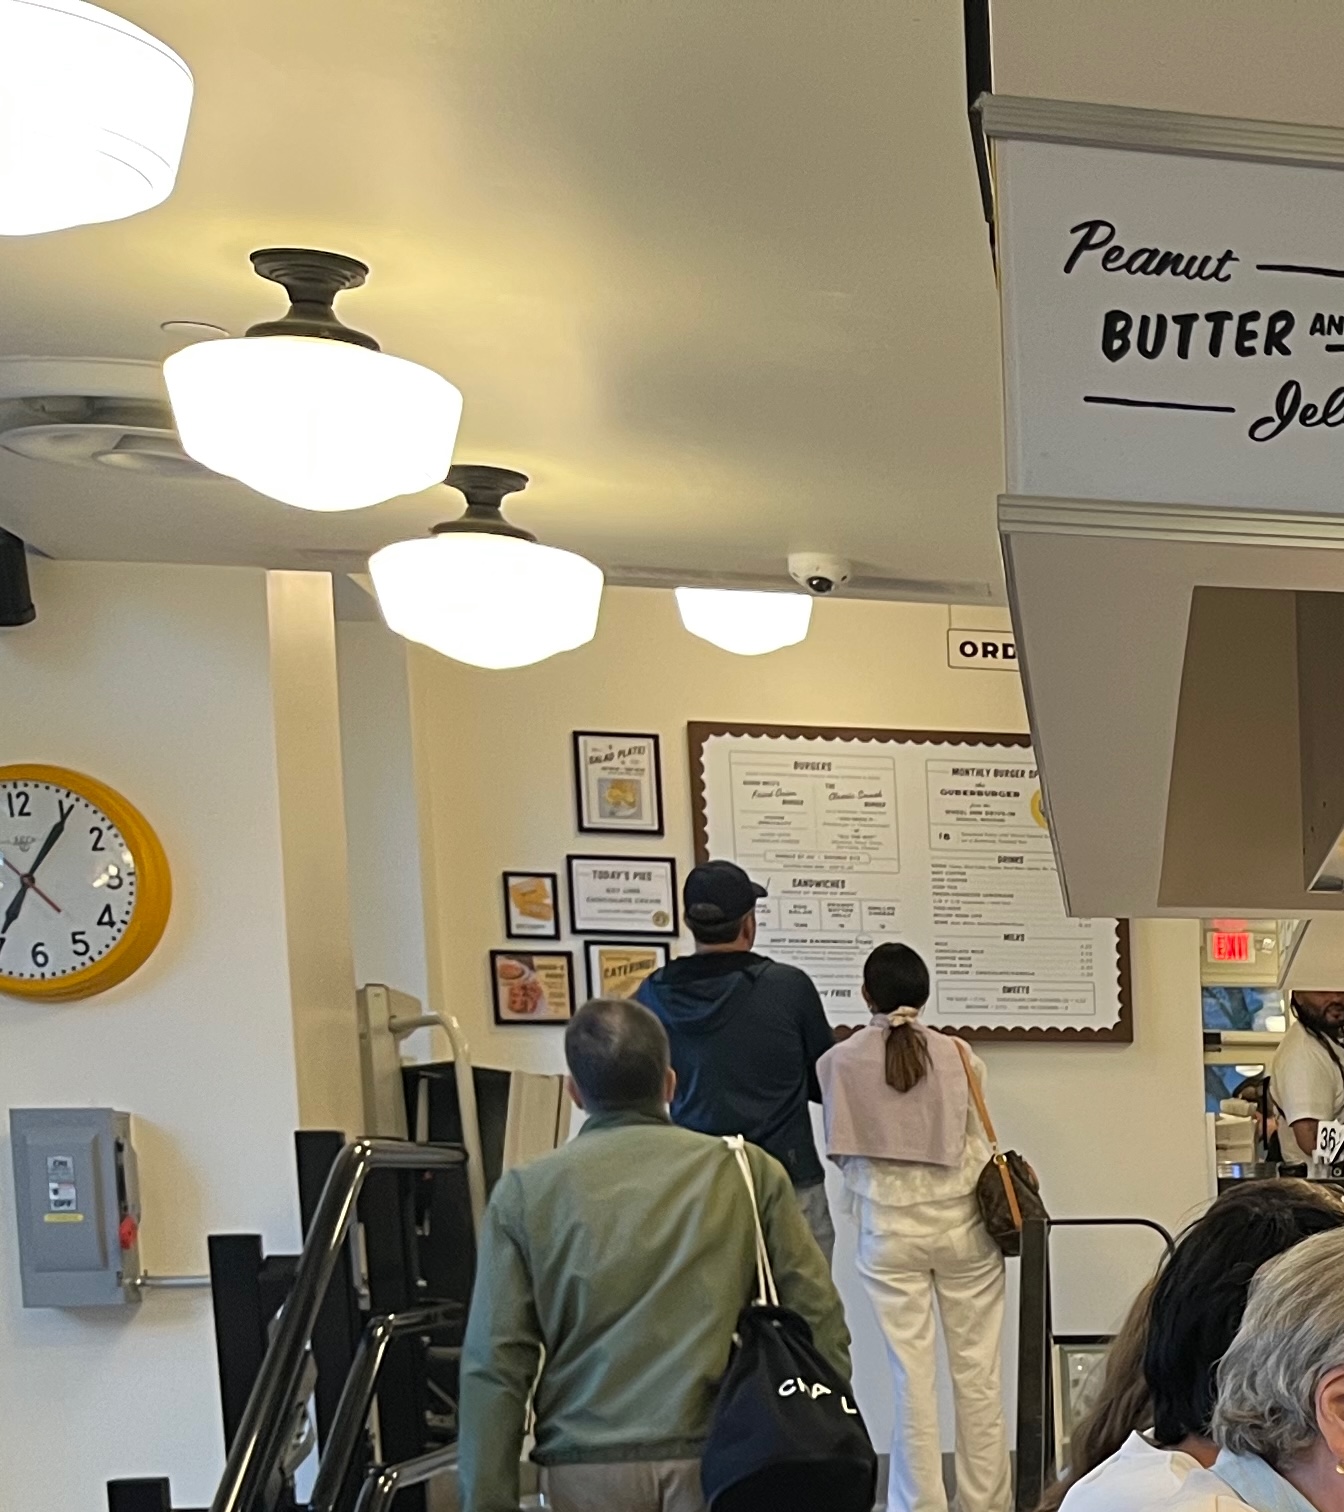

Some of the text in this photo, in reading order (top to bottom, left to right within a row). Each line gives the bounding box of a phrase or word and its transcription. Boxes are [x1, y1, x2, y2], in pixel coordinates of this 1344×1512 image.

[1063, 219, 1240, 283] Peanut
[1101, 309, 1296, 363] BUTTER
[951, 767, 991, 777] MONTHLY
[993, 768, 1026, 778] BURGER
[7, 791, 31, 817] 12
[89, 826, 105, 851] 2
[96, 903, 116, 928] 4
[31, 942, 49, 967] 6
[71, 931, 90, 956] 5
